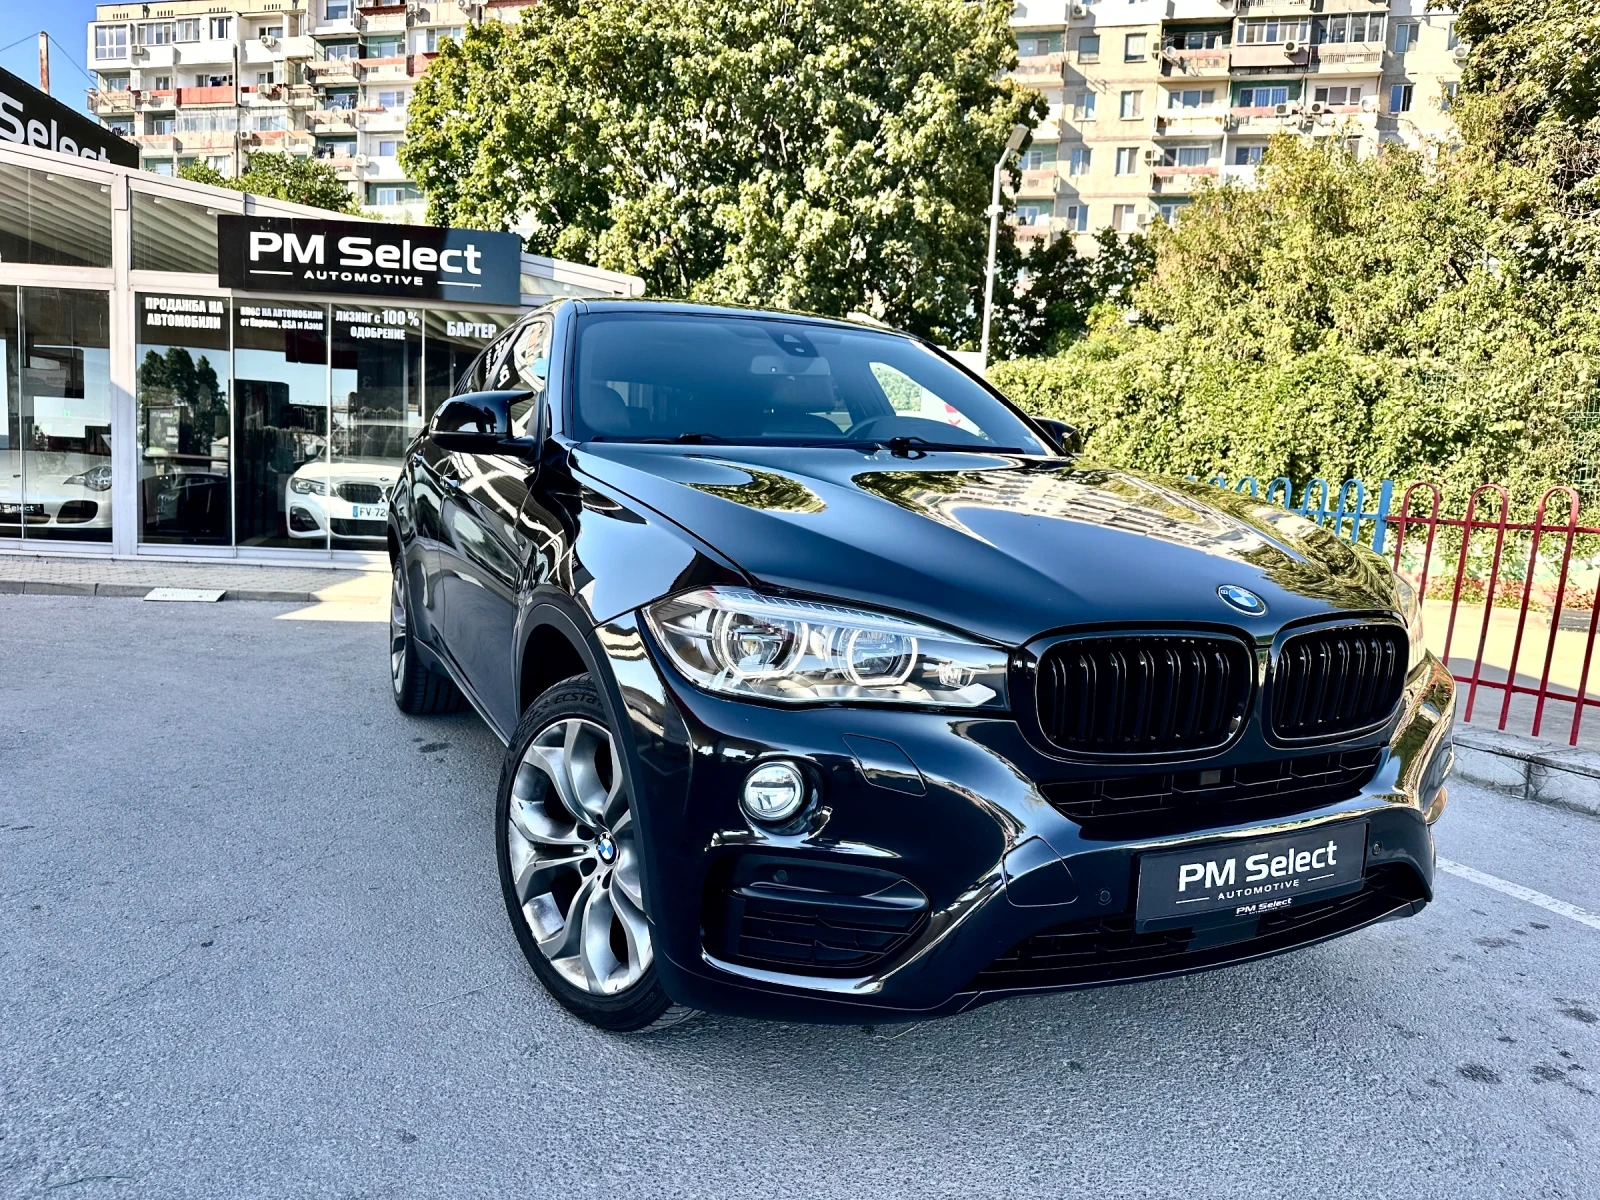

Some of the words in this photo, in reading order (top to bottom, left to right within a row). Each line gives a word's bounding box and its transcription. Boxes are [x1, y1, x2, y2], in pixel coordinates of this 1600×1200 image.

[249, 231, 325, 265] PM
[337, 236, 482, 275] Select
[303, 269, 424, 286] AUTOMOTIVE
[145, 296, 207, 313] ПРОДАЖБА
[208, 300, 224, 314] НА
[272, 308, 324, 320] АВТОМОБИЛИ
[146, 312, 221, 330] АВТОМОБИЛИ
[281, 319, 297, 330] USA
[335, 310, 374, 324] ЛИЗИНГ
[381, 309, 406, 326] 100
[350, 325, 406, 340] ОДОБРЕНИЕ
[446, 321, 497, 339] БАРТЕР
[1178, 858, 1236, 892] PM
[1245, 840, 1338, 883] Select
[1217, 878, 1300, 901] AUTOMOTIVE
[1236, 904, 1257, 915] PM
[1258, 897, 1293, 910] Select
